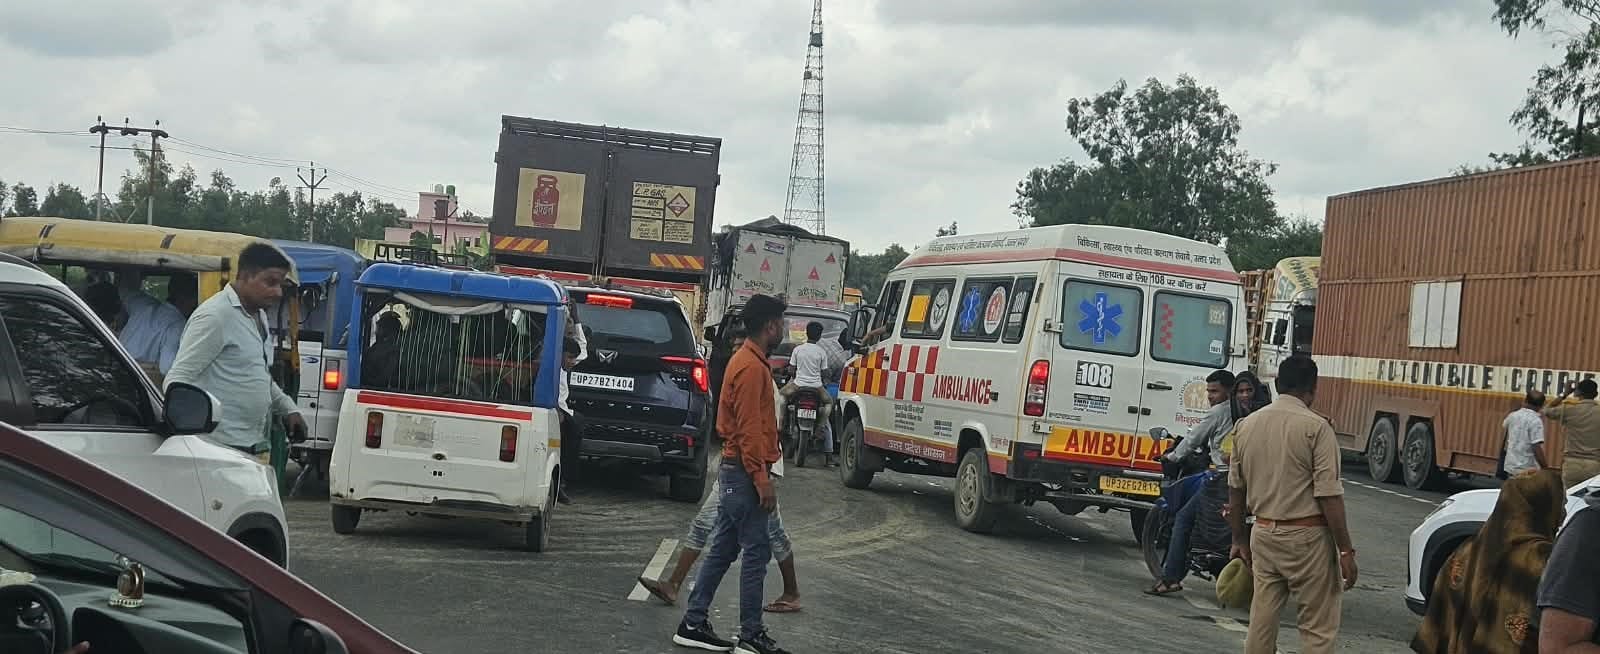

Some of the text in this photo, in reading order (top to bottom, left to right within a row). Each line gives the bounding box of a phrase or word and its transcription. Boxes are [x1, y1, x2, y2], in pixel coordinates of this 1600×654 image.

[1151, 275, 1165, 285] 108
[576, 372, 633, 391] UP27BZ1404
[1080, 363, 1112, 387] 108
[1377, 359, 1494, 389] AUTOMOBILE
[932, 375, 992, 405] AMBULANCE
[1064, 428, 1173, 463] AMBULA
